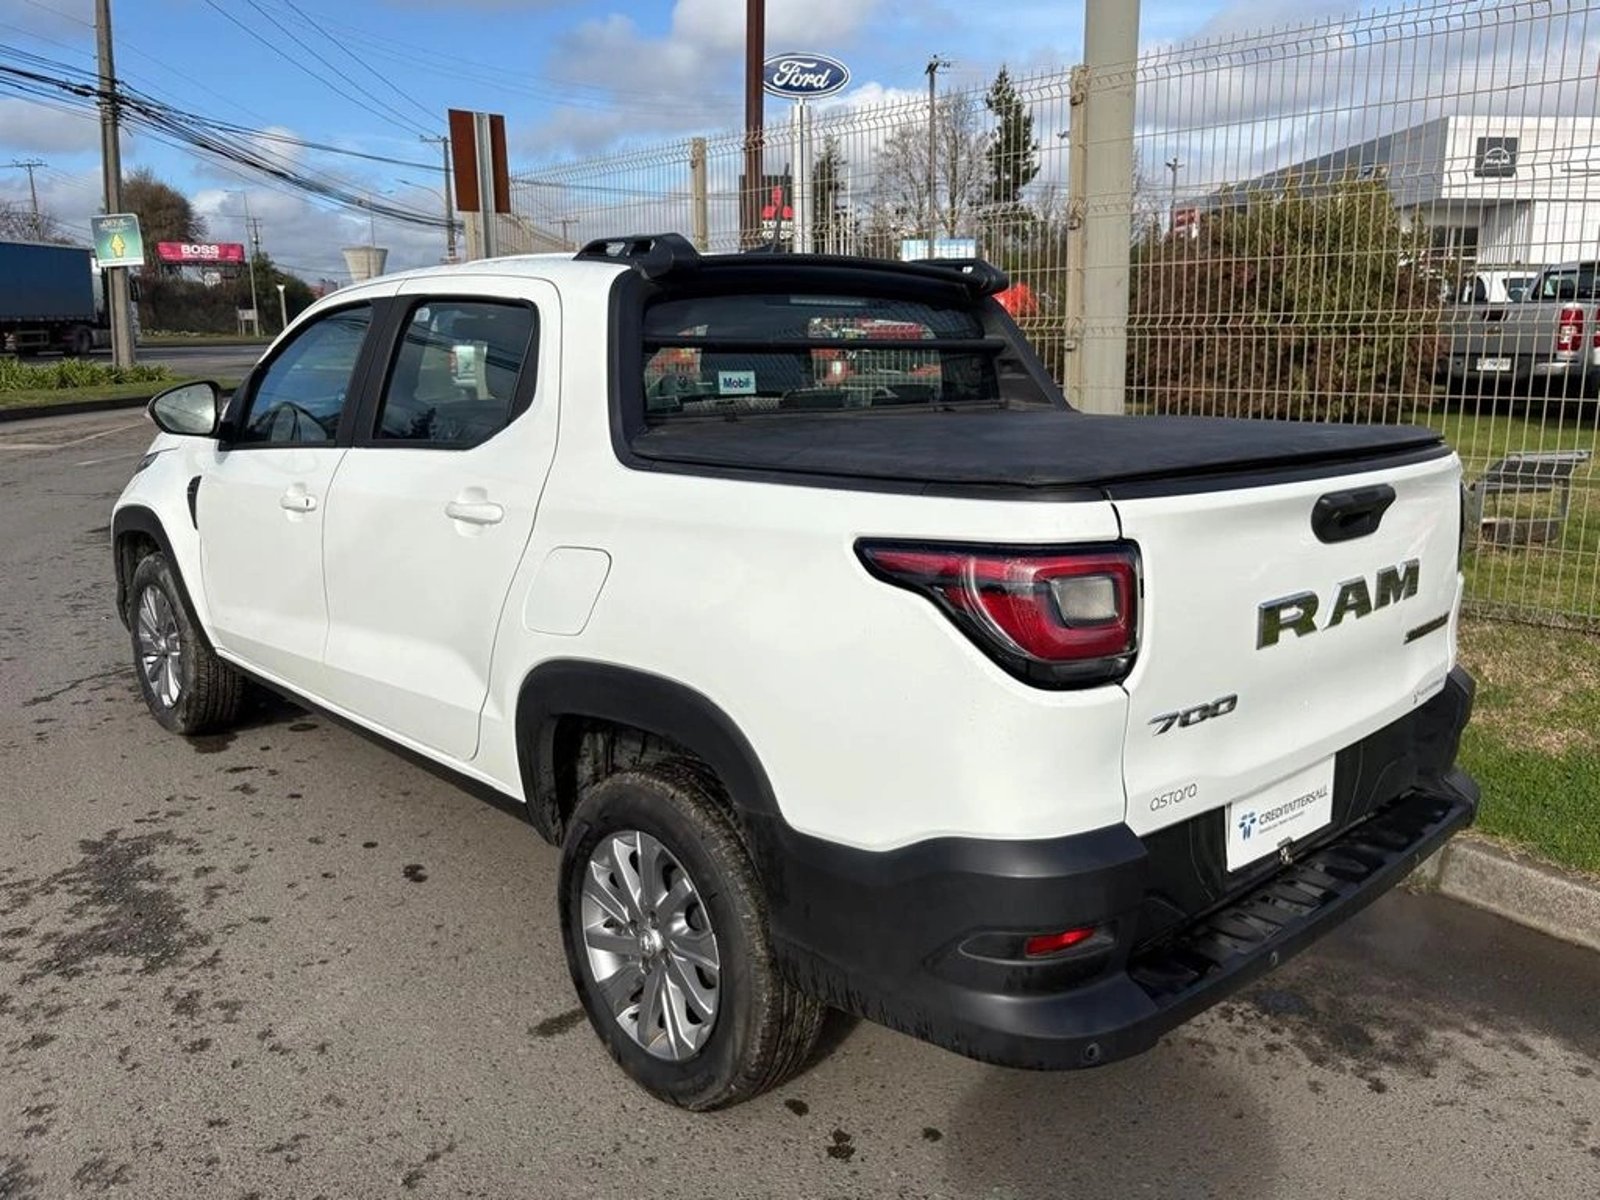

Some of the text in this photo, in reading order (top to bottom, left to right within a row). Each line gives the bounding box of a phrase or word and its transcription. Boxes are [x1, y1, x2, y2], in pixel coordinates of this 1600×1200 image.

[773, 60, 831, 88] Ford
[180, 244, 219, 254] BOSS
[1256, 558, 1420, 650] RAM
[1147, 694, 1238, 737] 700
